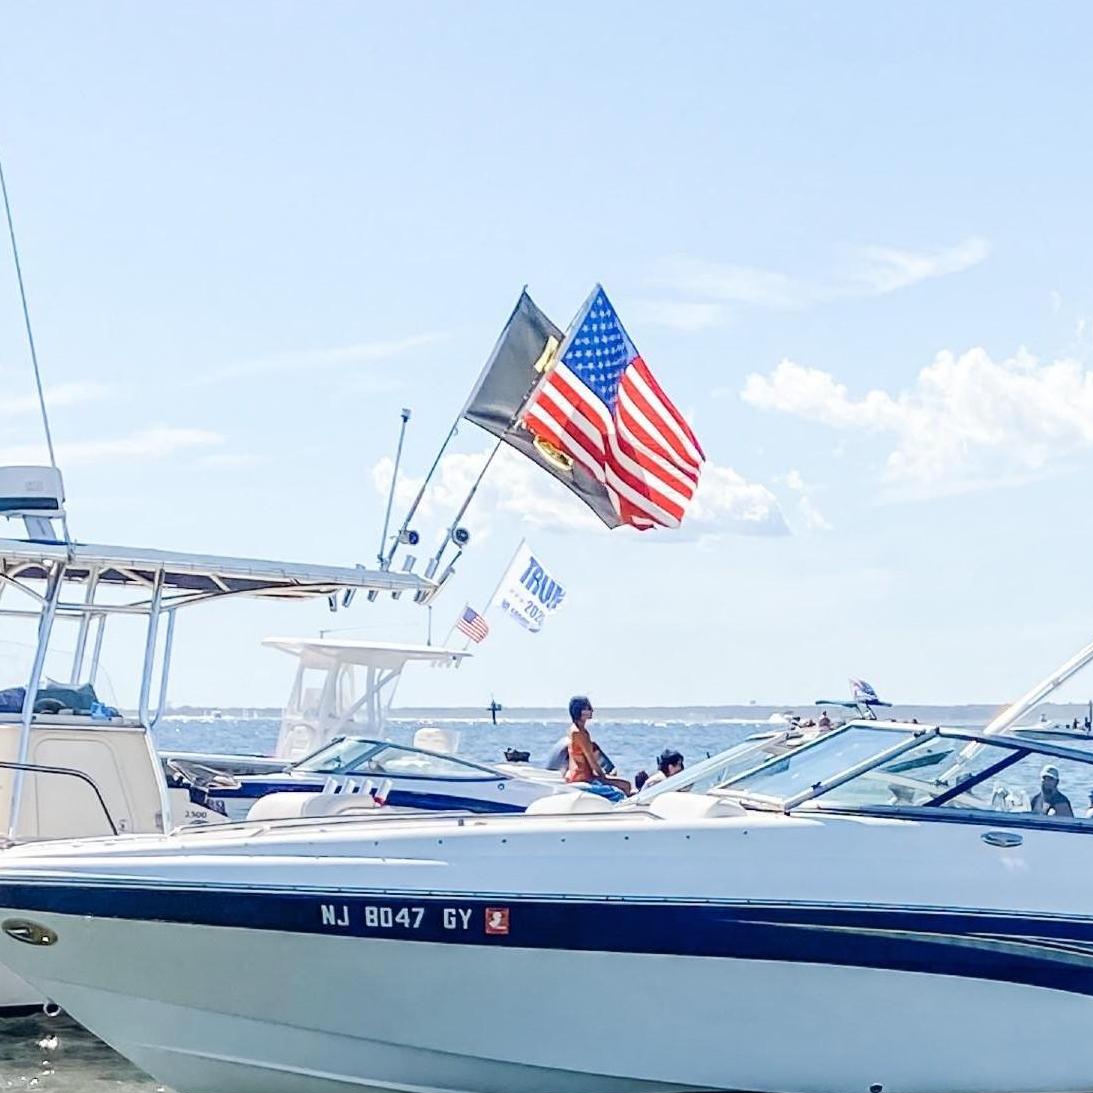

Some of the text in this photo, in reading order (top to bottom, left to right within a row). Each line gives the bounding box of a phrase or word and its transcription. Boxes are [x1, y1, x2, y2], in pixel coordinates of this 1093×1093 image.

[519, 555, 566, 609] TRUM
[524, 600, 546, 624] 202
[320, 904, 473, 930] NJ 8047 GY
